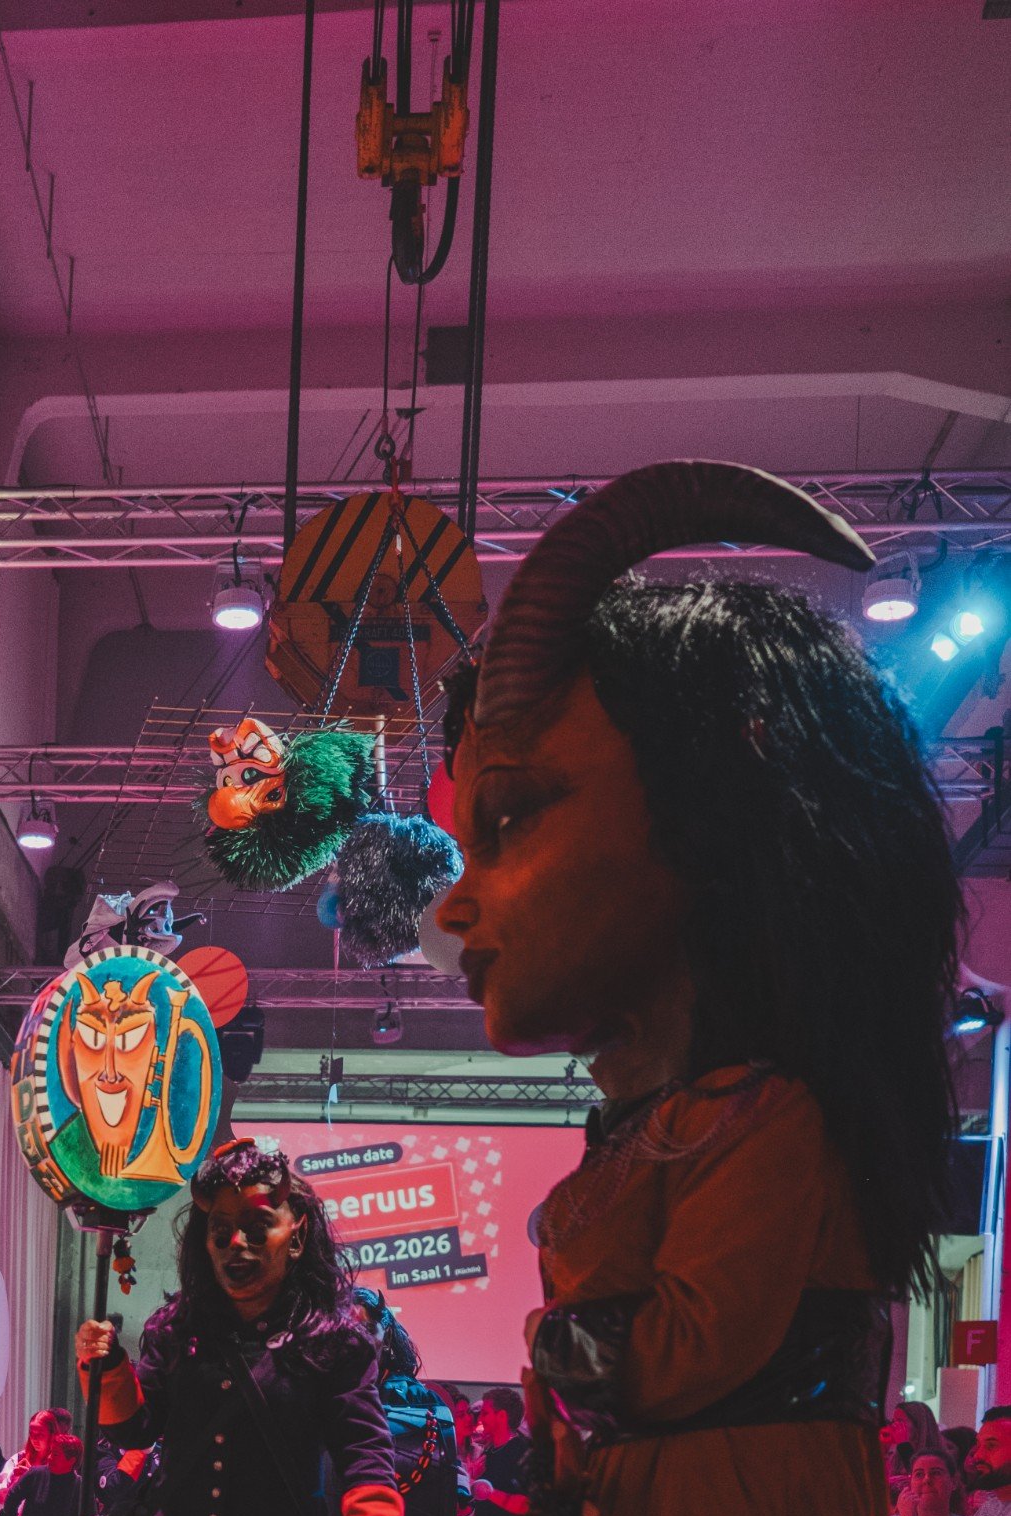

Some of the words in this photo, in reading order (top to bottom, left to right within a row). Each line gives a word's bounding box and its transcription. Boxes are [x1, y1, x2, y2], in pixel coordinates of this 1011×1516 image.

[301, 1156, 335, 1172] Save
[336, 1151, 360, 1167] the
[363, 1147, 395, 1163] date
[322, 1184, 436, 1220] eeruus
[391, 1270, 410, 1285] im
[411, 1265, 442, 1283] Saal
[443, 1264, 451, 1277] 1
[965, 1328, 986, 1360] F
